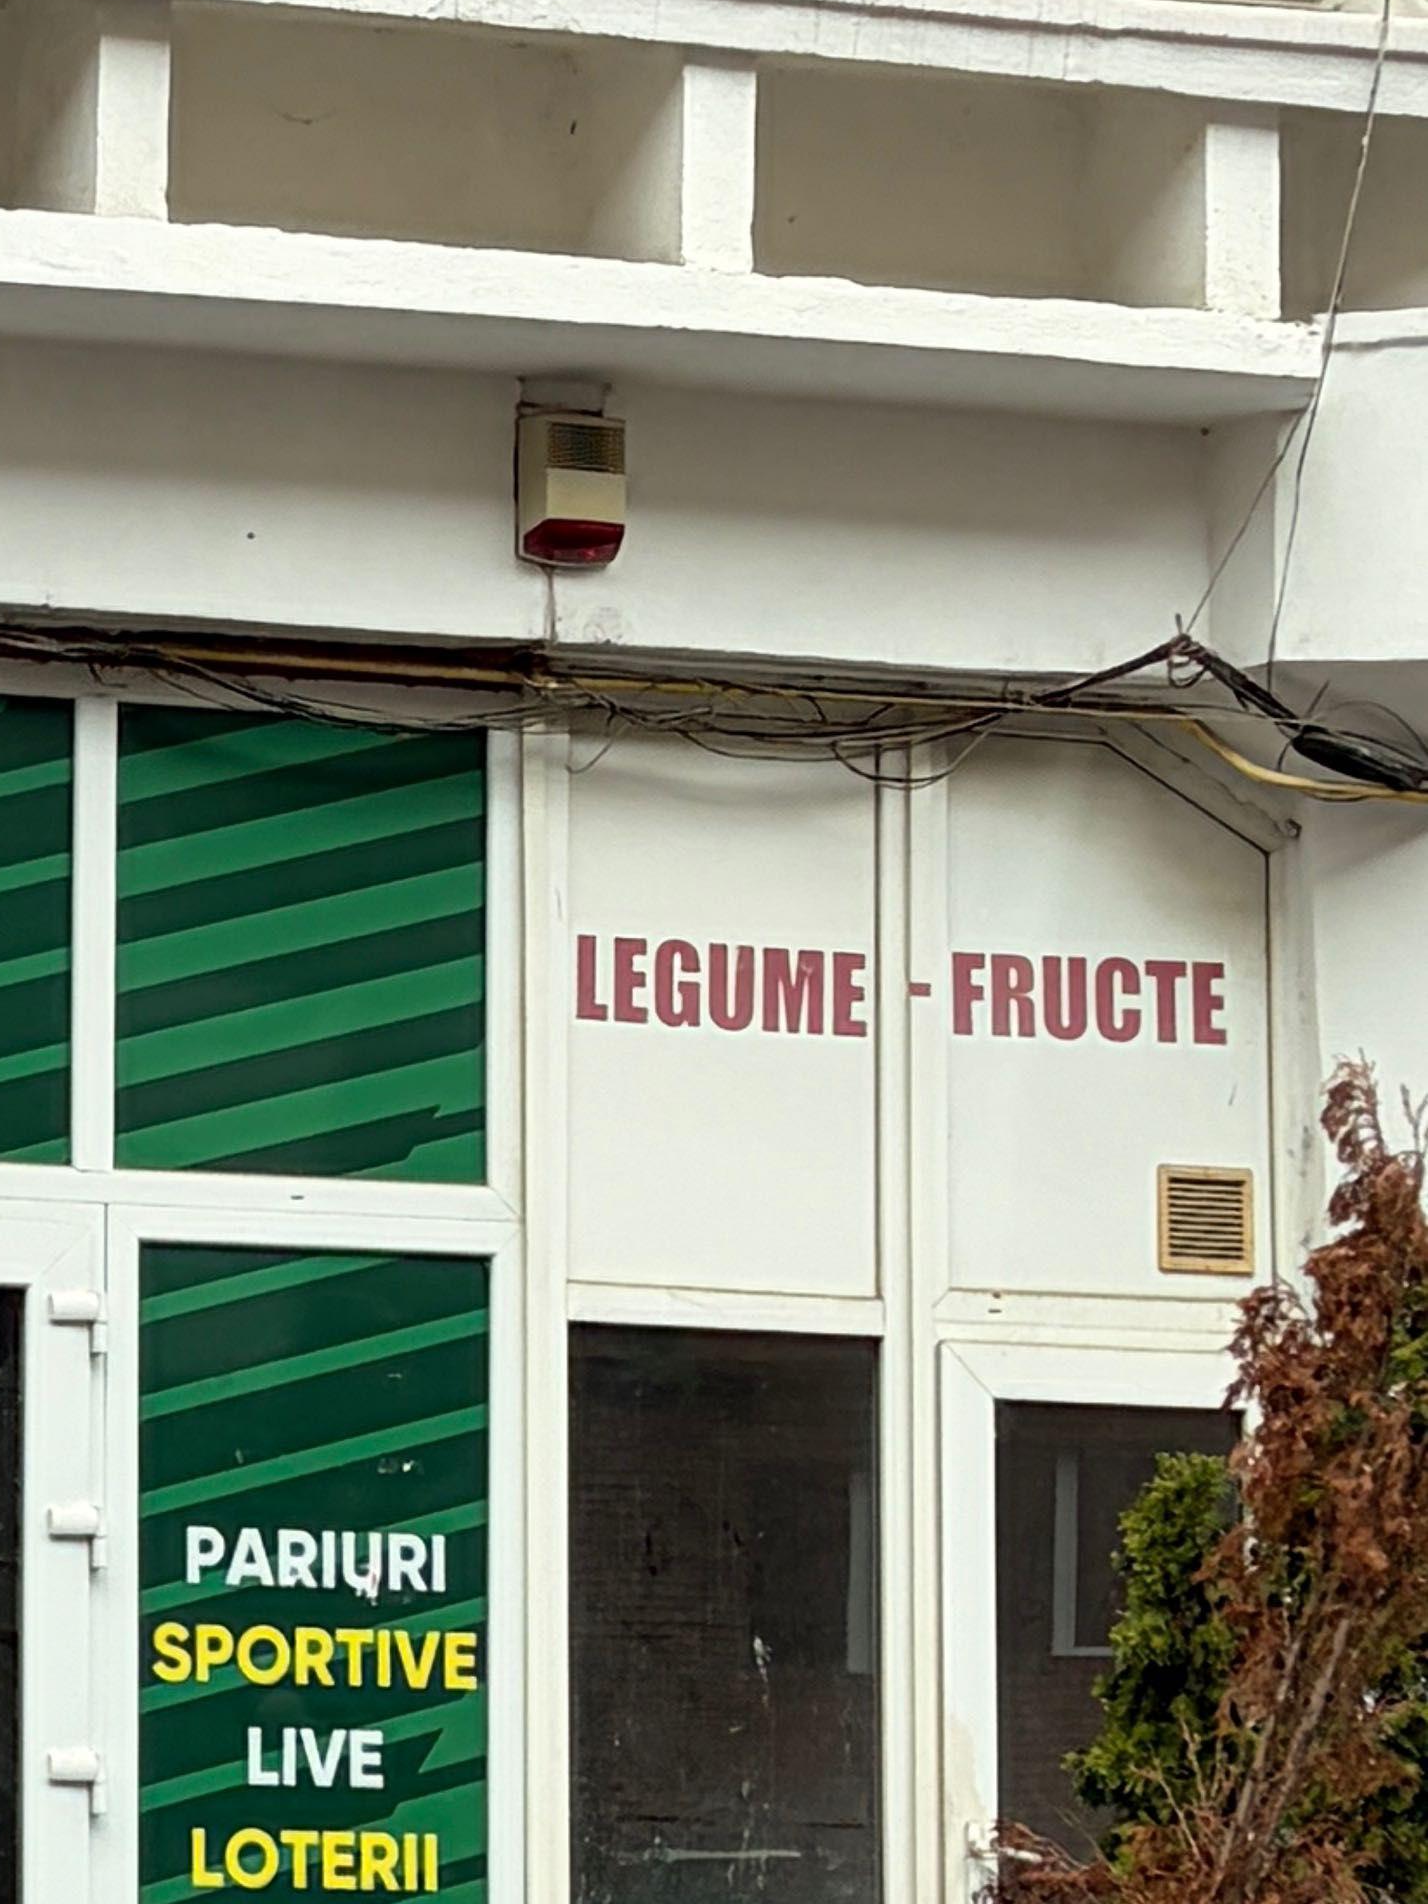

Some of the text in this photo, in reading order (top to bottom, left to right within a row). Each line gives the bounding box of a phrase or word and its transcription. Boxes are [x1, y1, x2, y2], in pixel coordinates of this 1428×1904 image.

[575, 934, 868, 1038] LEGUME
[951, 951, 1228, 1045] FRUCTE
[185, 1525, 447, 1593] PARIURI
[152, 1621, 478, 1691] SPORTIVE
[246, 1726, 385, 1789] LIVE
[190, 1827, 439, 1893] LOTERII
